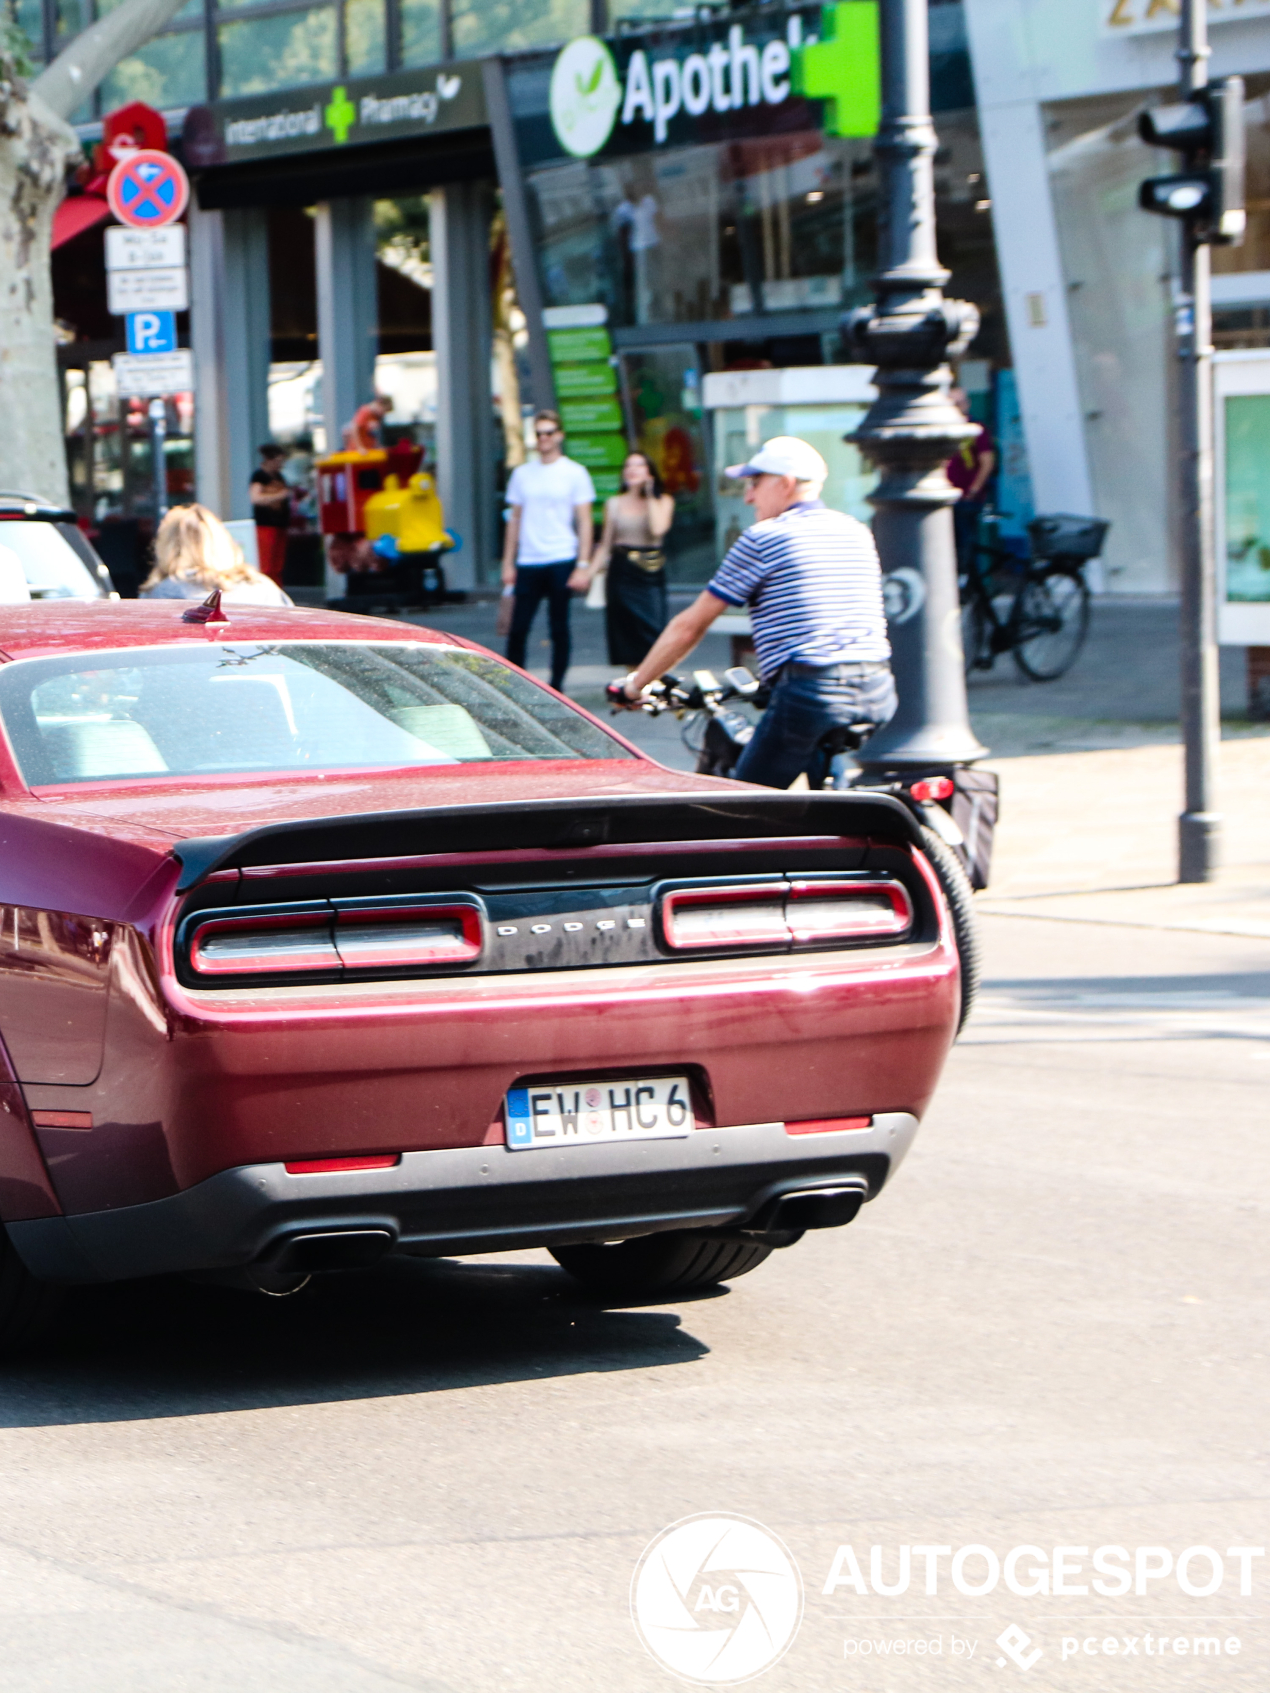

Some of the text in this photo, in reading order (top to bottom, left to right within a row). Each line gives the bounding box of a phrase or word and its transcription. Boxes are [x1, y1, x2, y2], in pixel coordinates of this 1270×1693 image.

[360, 92, 437, 125] Pharmacy
[133, 313, 161, 350] P
[496, 917, 647, 936] DODGE
[514, 1122, 527, 1136] D
[531, 1091, 580, 1138] EW
